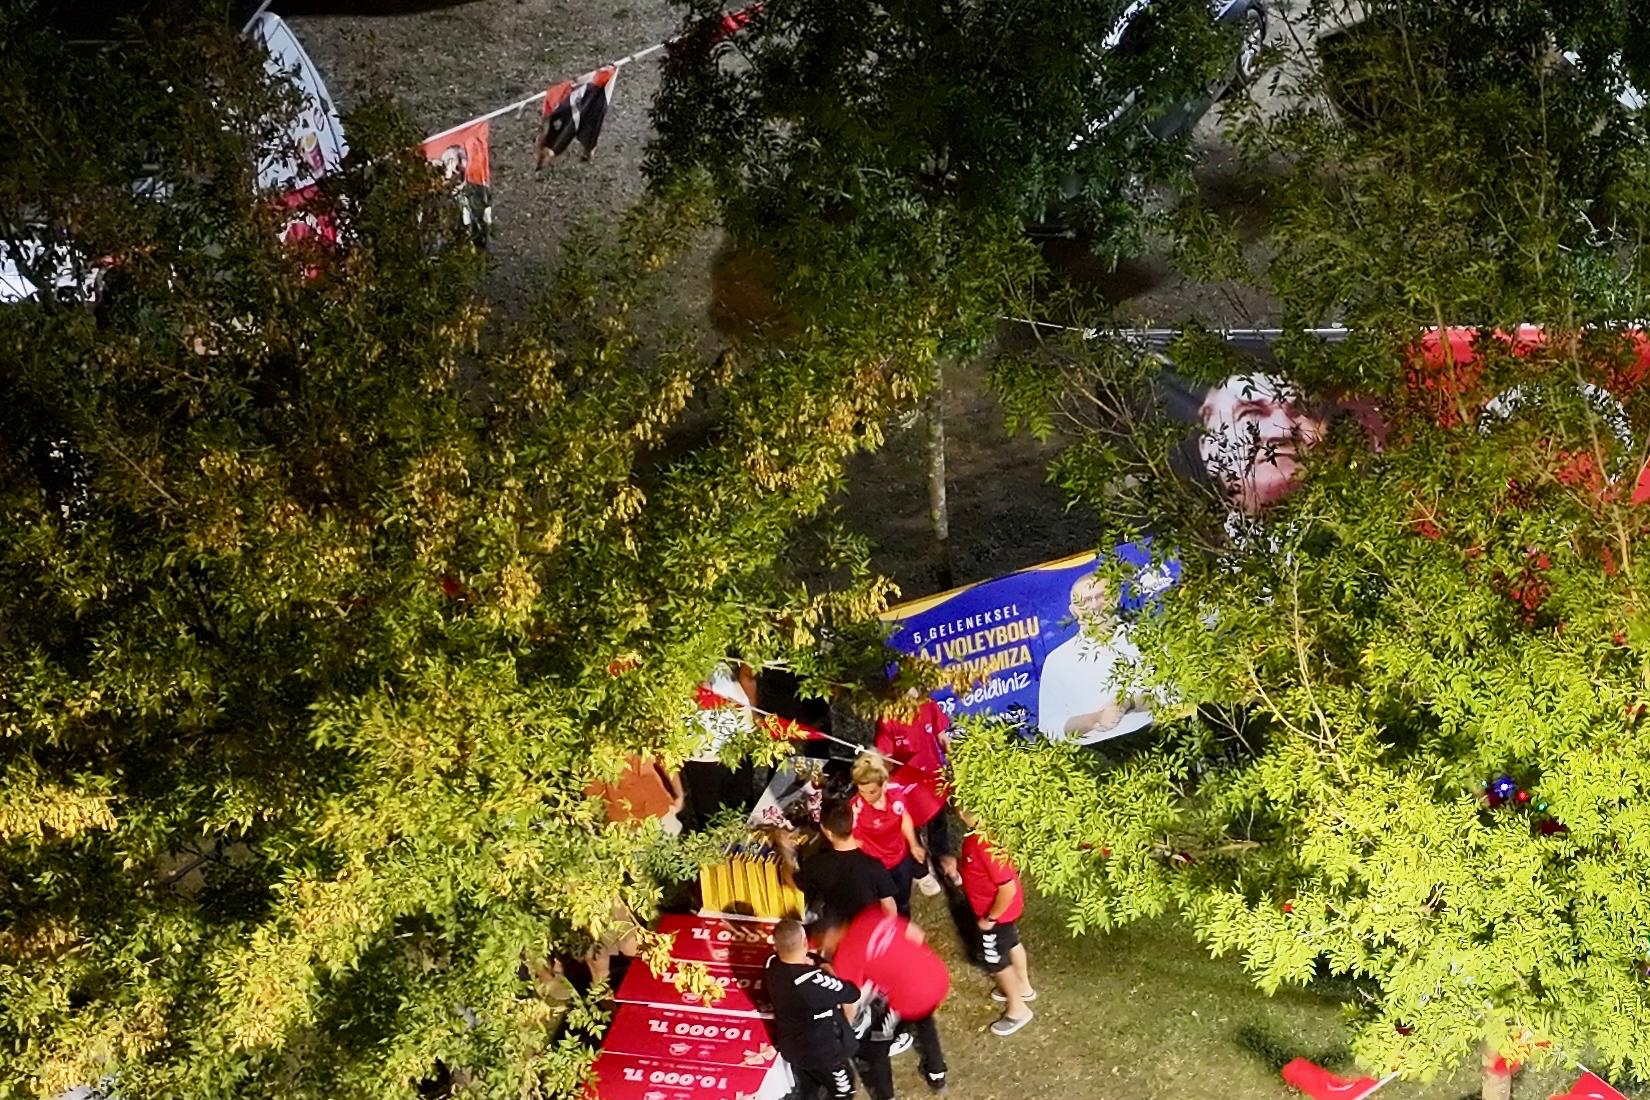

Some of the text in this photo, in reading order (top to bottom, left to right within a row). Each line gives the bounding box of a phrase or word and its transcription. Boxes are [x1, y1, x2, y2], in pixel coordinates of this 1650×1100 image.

[943, 616, 1041, 660] VOLEYBOLU
[648, 1019, 752, 1041] 10.000 TL
[623, 1067, 728, 1090] 10.000 TL
